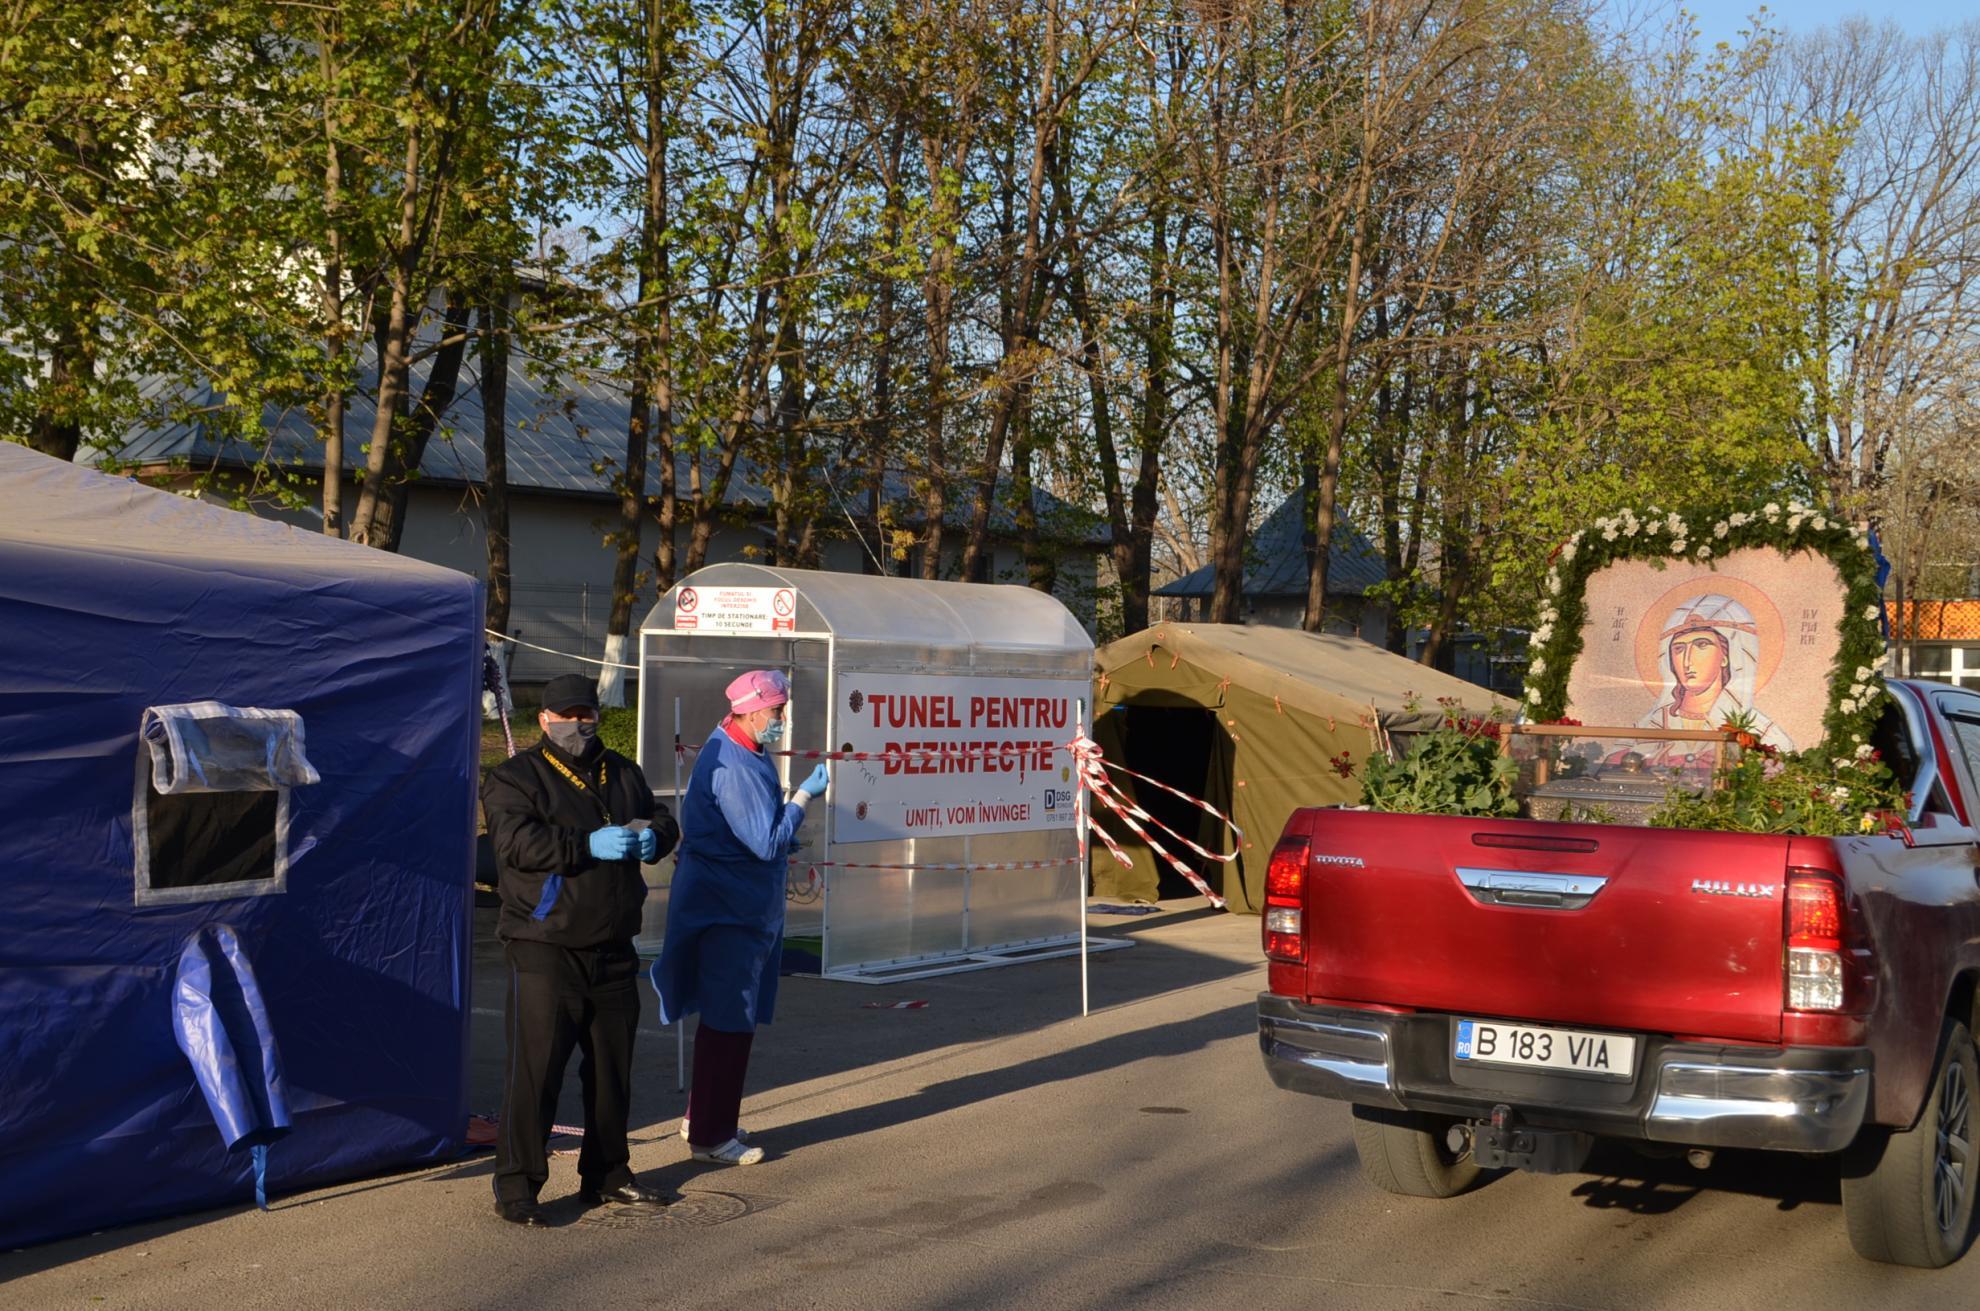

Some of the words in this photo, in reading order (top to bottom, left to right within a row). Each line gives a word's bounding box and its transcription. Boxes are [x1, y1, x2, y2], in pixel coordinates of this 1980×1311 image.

[868, 694, 961, 728] TUNEL
[970, 696, 1068, 729] PENTRU
[1056, 791, 1071, 801] DSG
[905, 808, 943, 832] UNIȚI,
[946, 806, 976, 825] VOM
[978, 800, 1031, 823] ÎNVINGE!
[1315, 855, 1365, 868] TOYOTA
[1692, 879, 1775, 898] HILUX
[1457, 1041, 1471, 1054] RO
[1477, 1027, 1497, 1056] B
[1510, 1030, 1553, 1061] 183
[1568, 1035, 1609, 1068] VIA
